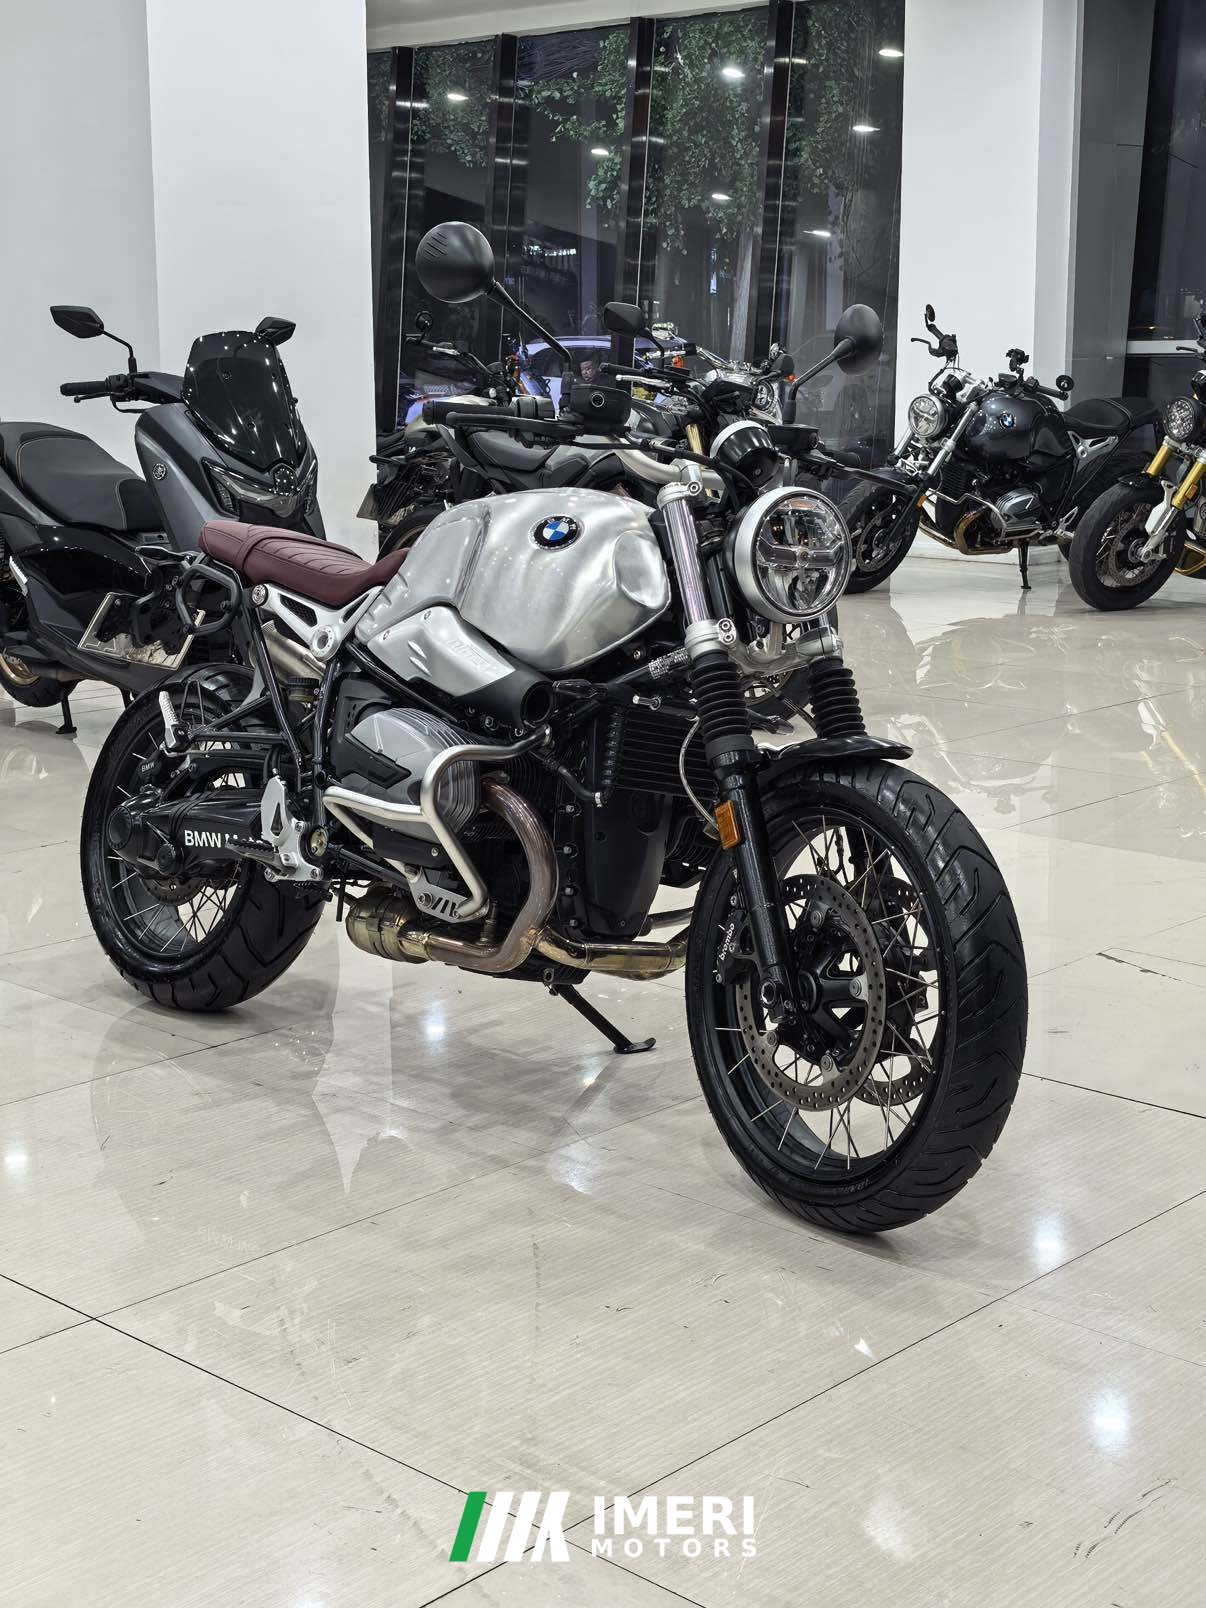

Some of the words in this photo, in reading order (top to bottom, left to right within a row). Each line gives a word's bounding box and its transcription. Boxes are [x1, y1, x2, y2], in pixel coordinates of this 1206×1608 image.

[141, 761, 155, 772] BMW
[184, 829, 222, 848] BMW
[718, 923, 735, 961] brembo
